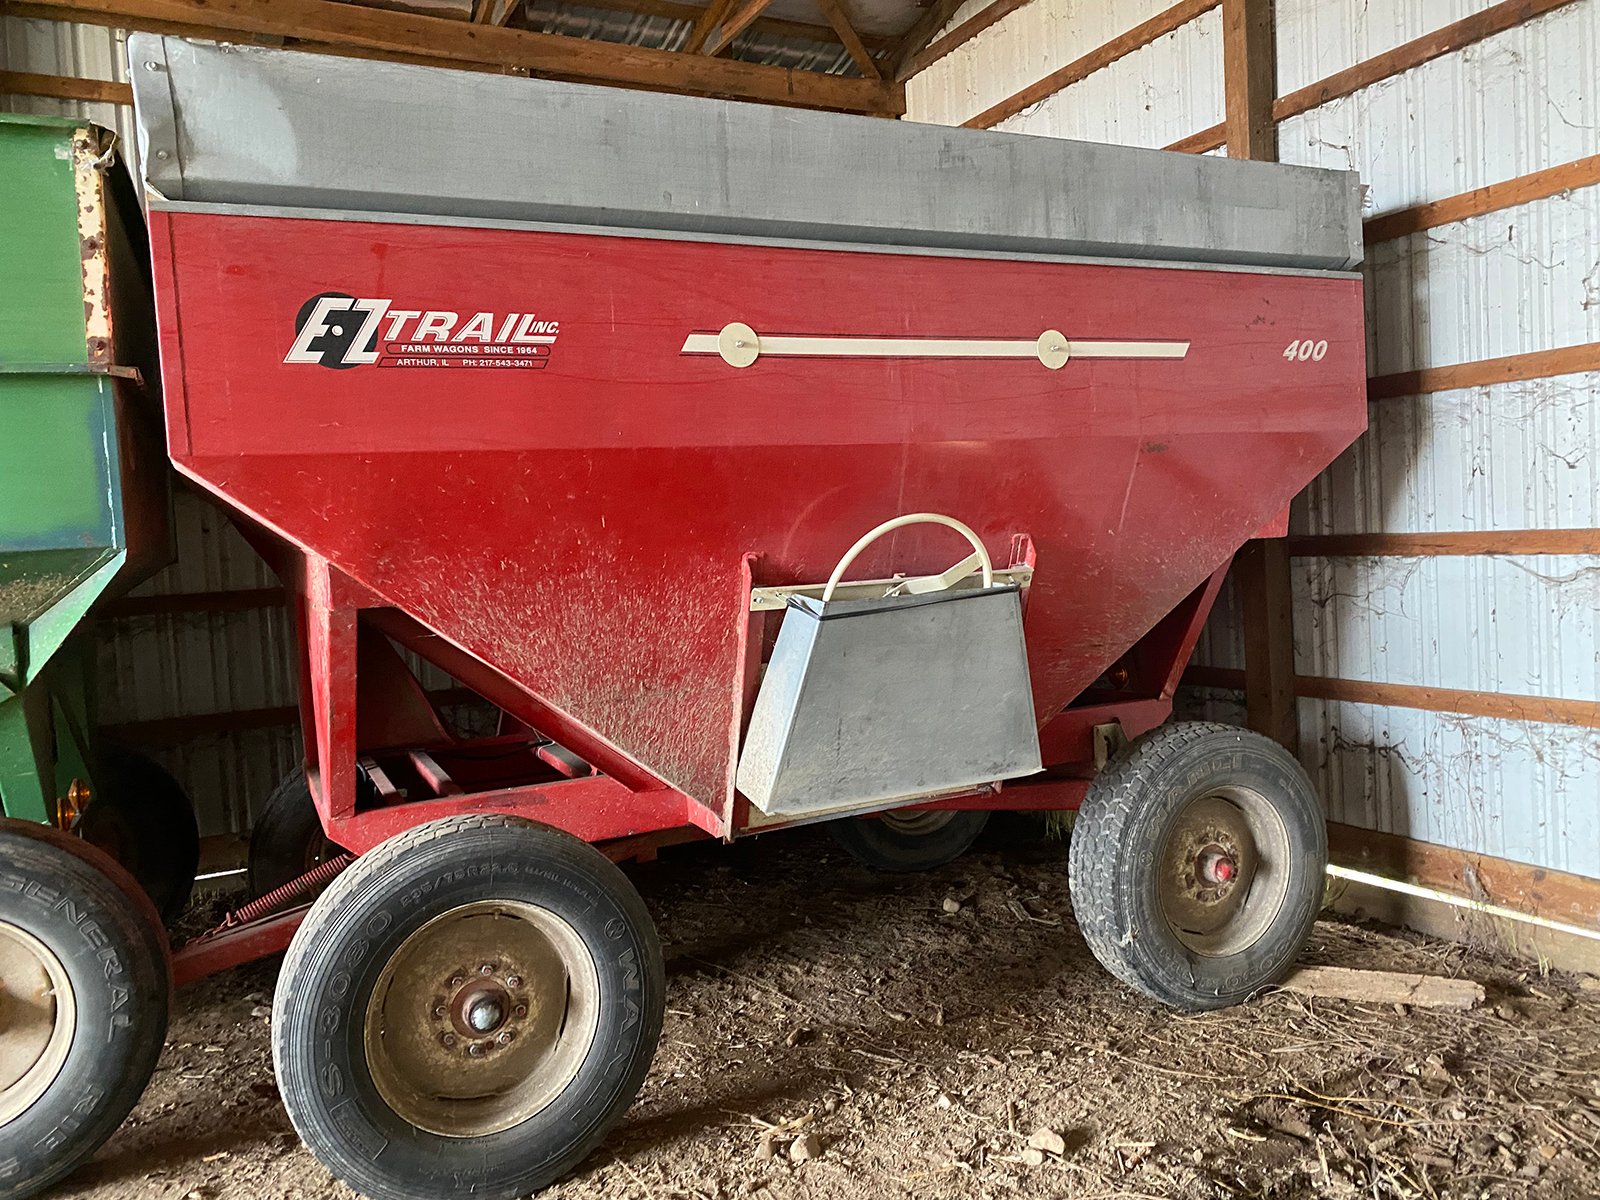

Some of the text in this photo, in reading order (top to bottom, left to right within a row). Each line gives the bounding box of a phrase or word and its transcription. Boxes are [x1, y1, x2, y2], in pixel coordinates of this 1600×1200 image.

[383, 310, 558, 344] TRAIL
[529, 321, 560, 334] INC.
[401, 344, 431, 353] FARM
[433, 345, 479, 354] WAGONS
[483, 346, 513, 354] SINCE
[1282, 339, 1328, 362] 400
[396, 358, 533, 367] ARTHUR, IL PH: 217-543-3471
[0, 872, 133, 1043] GENERAL
